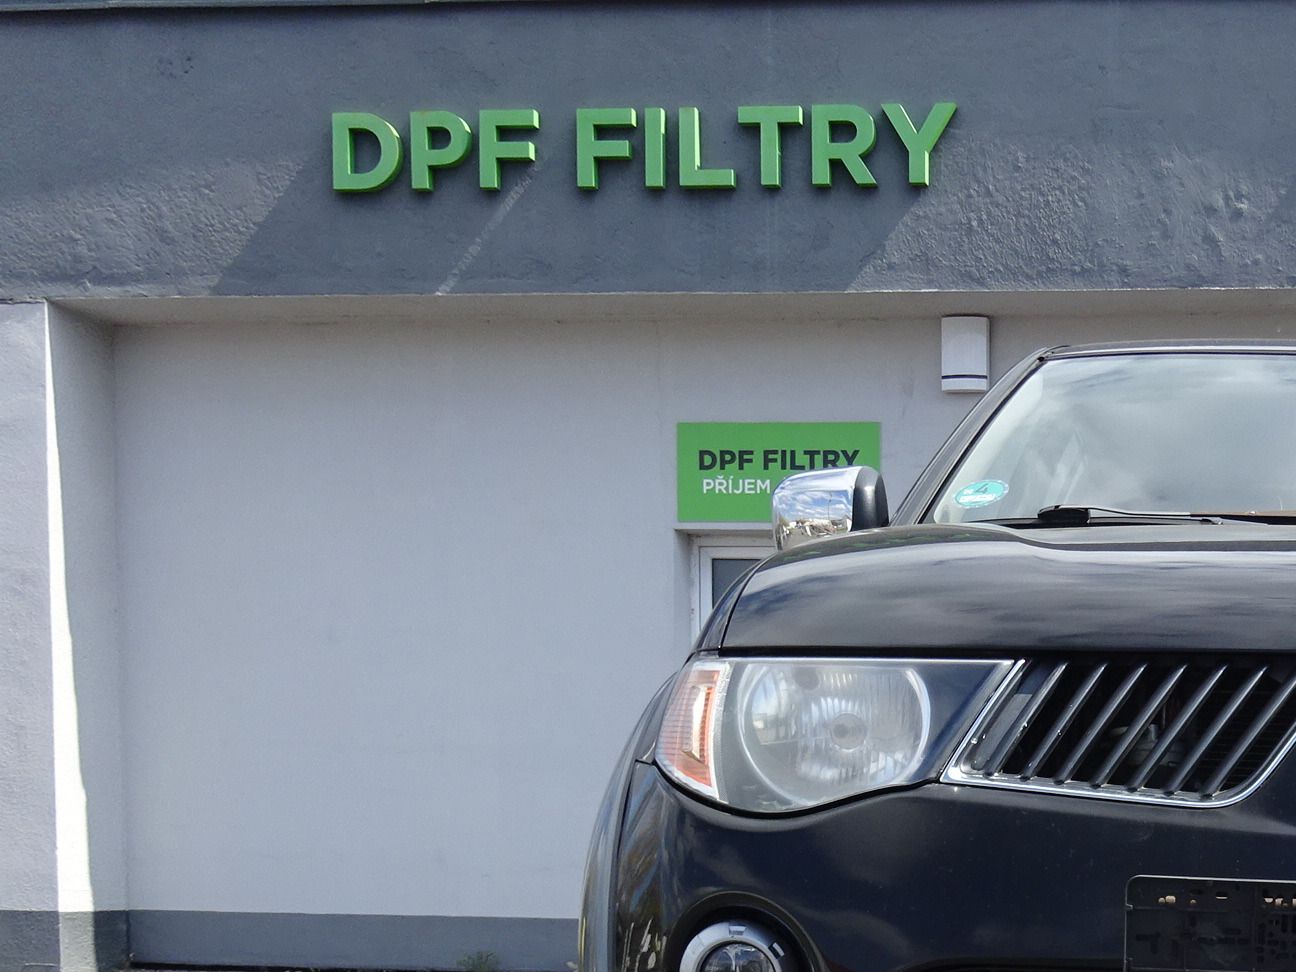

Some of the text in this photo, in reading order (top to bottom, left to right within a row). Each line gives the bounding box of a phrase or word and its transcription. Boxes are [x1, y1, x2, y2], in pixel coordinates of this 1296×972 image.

[331, 102, 957, 191] DPF FILTRY
[698, 449, 861, 471] DPF FILTRY
[702, 475, 771, 495] PŘÍJEM
